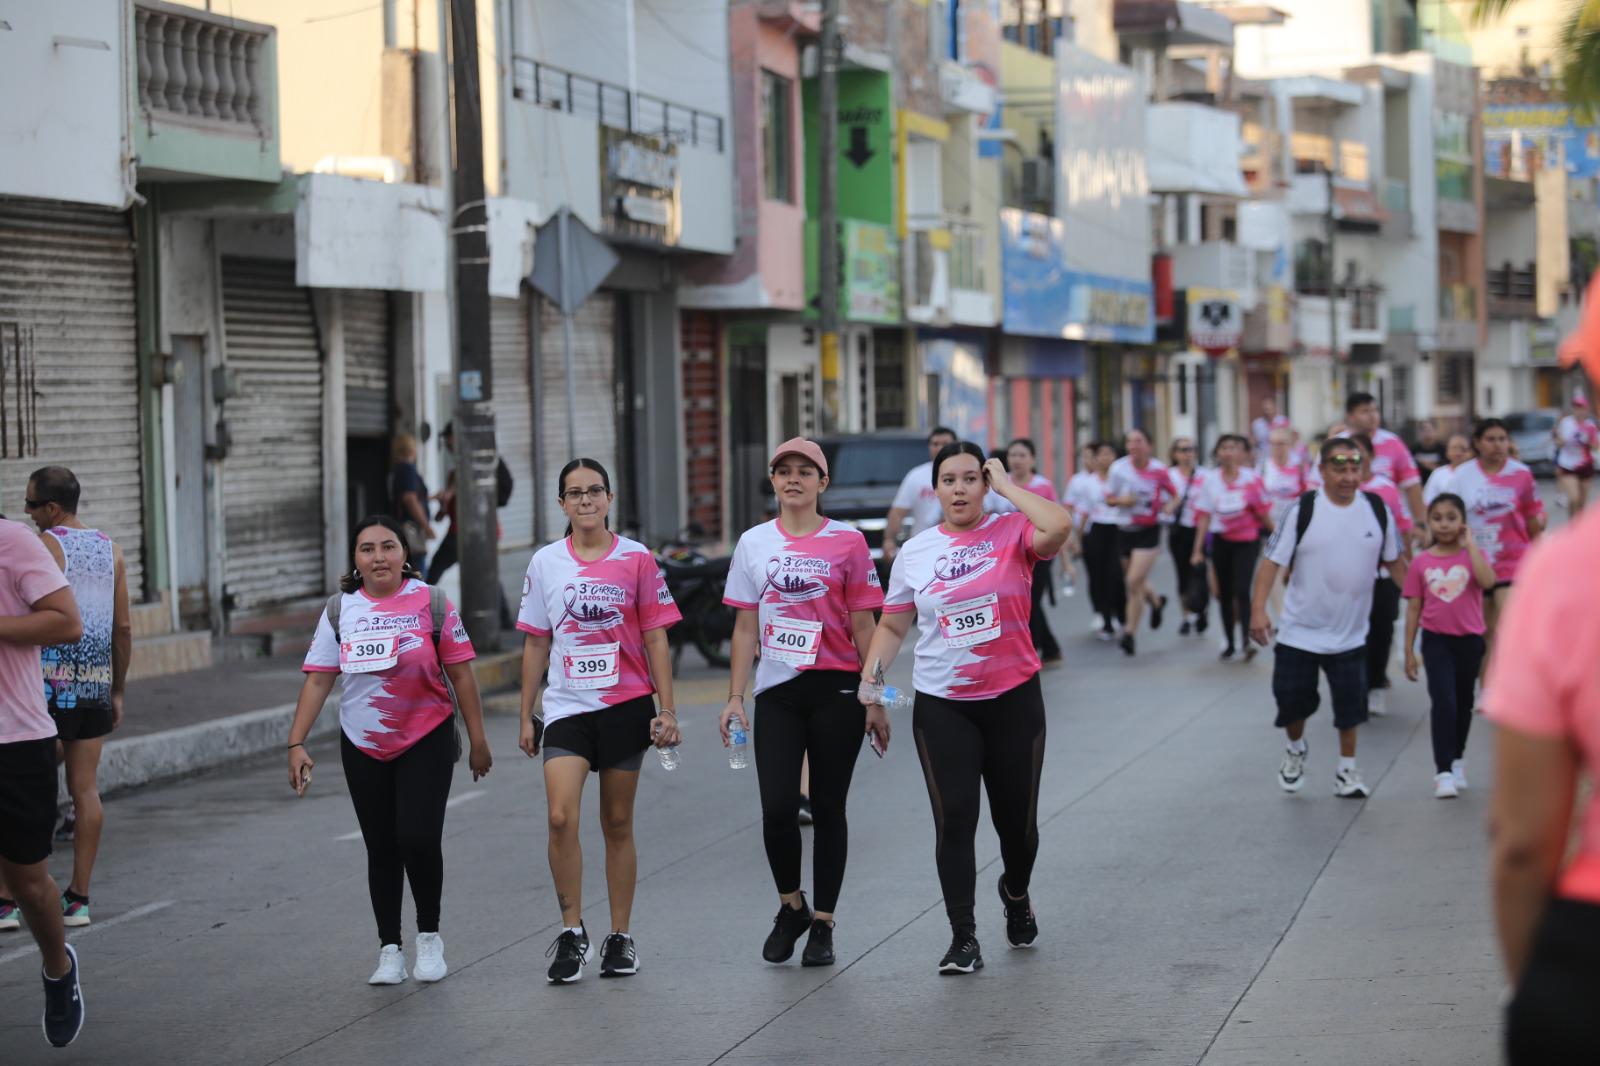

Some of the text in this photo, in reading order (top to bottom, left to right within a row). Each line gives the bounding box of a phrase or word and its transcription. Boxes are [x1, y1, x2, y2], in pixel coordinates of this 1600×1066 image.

[954, 612, 986, 631] 395
[776, 632, 806, 648] 400
[355, 643, 385, 657] 390
[577, 659, 608, 674] 399
